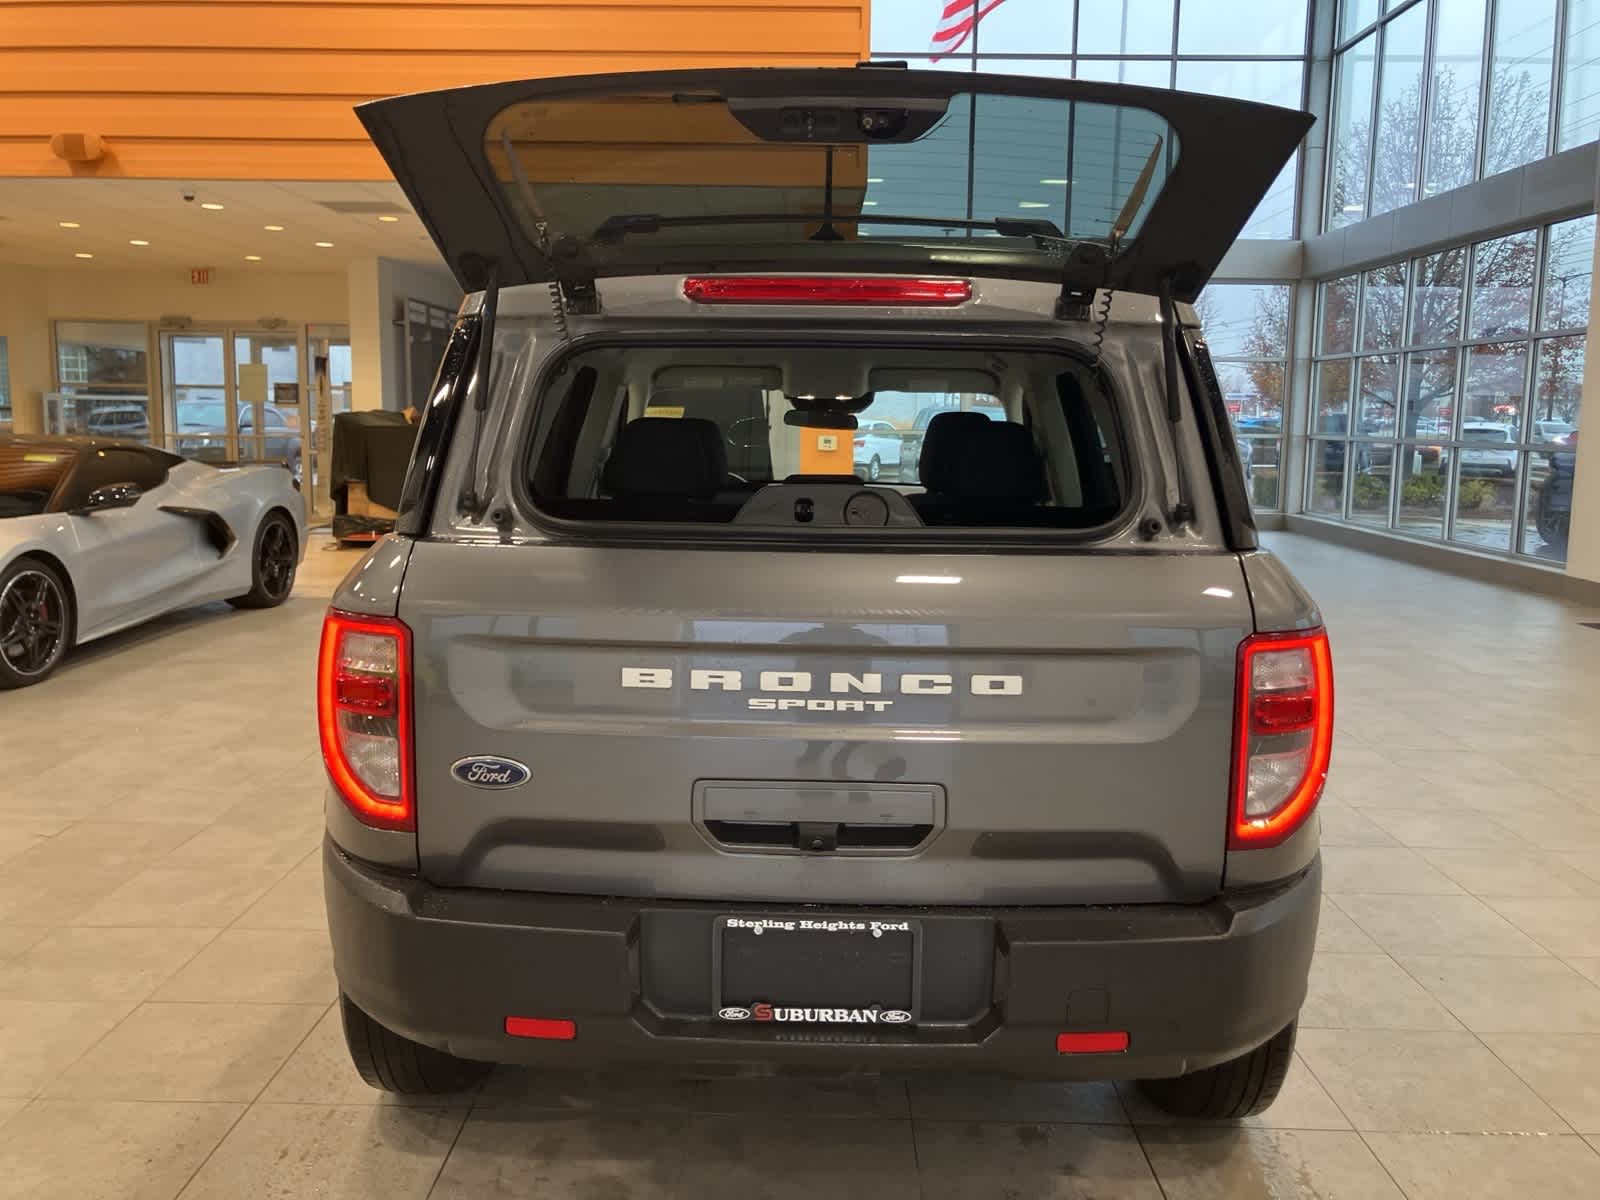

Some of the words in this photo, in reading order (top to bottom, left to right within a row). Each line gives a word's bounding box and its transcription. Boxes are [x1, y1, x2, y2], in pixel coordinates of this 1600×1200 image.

[622, 667, 1023, 695] BRONCO
[748, 698, 893, 712] SPORT
[467, 762, 512, 783] Ford
[727, 918, 795, 931] Sterling
[799, 920, 865, 931] Heights
[869, 921, 909, 931] Ford
[754, 1004, 877, 1023] SUBURBAN
